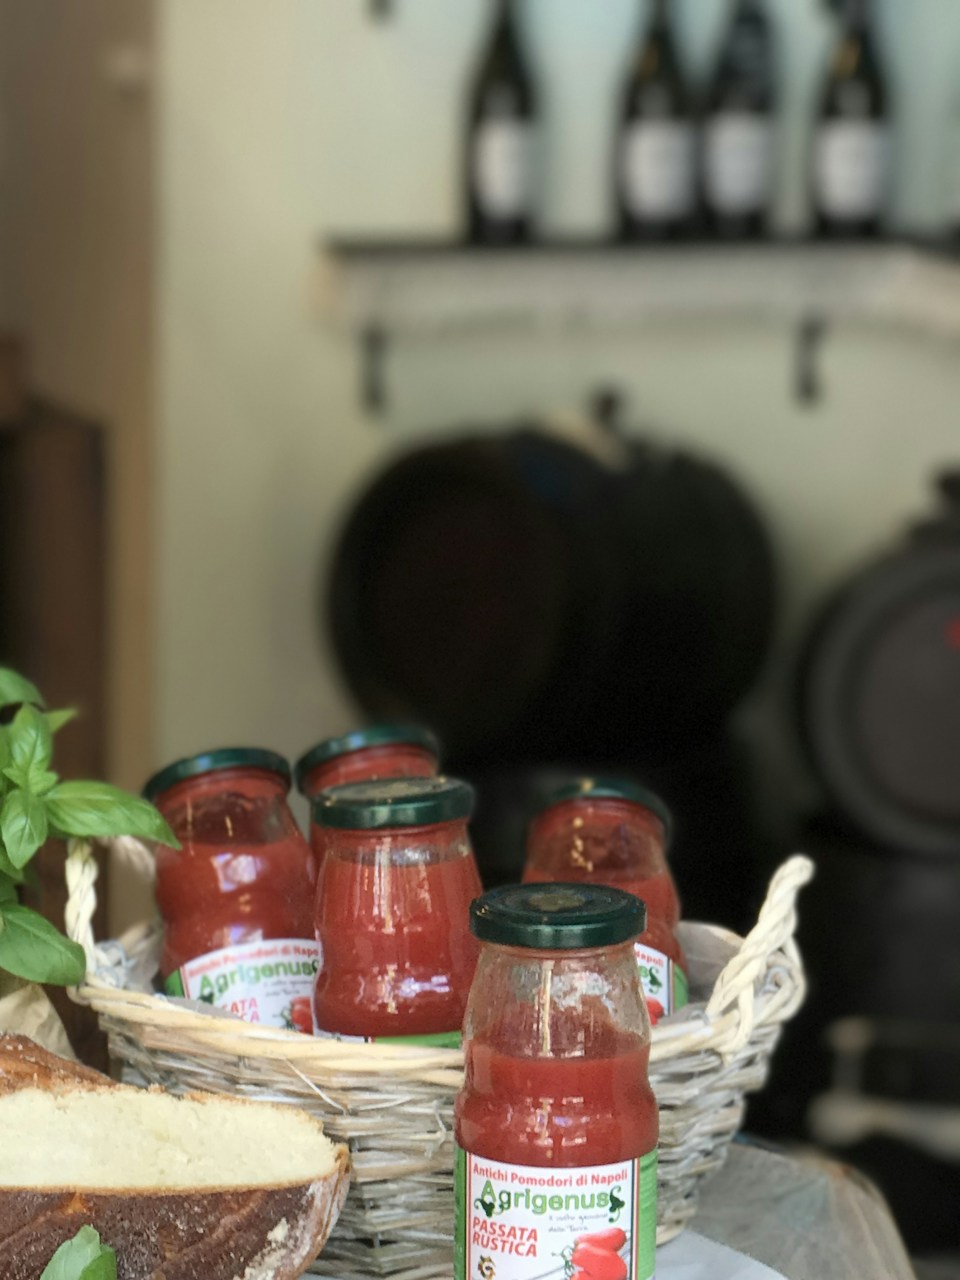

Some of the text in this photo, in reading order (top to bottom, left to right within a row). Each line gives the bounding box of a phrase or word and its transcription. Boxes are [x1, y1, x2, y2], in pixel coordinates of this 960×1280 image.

[473, 1163, 628, 1187] Antichi Pomodori di Napoli
[478, 1180, 611, 1215] Agrigenus
[472, 1216, 538, 1243] PASSATA
[472, 1230, 538, 1258] RUSTICA
